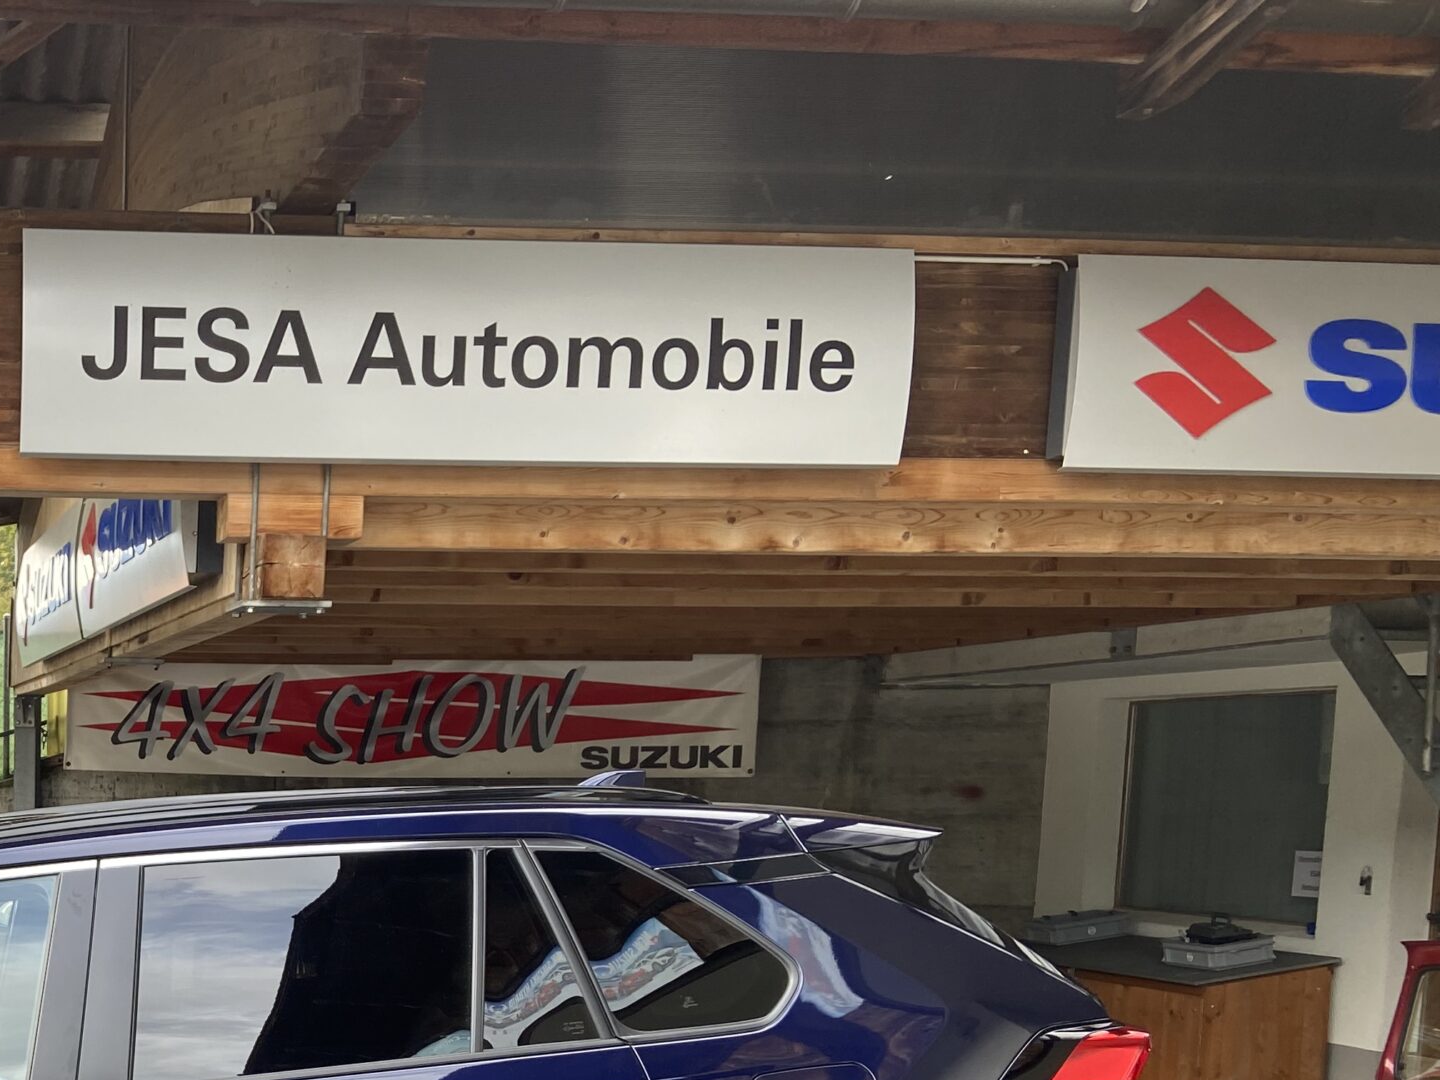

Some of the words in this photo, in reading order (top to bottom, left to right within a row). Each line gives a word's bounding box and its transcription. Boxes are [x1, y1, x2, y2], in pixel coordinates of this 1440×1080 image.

[80, 304, 324, 386] JESA
[347, 310, 856, 393] Automobile
[111, 672, 285, 760] 4X4
[305, 665, 587, 765] SHOW
[579, 744, 743, 770] SUZUKI
